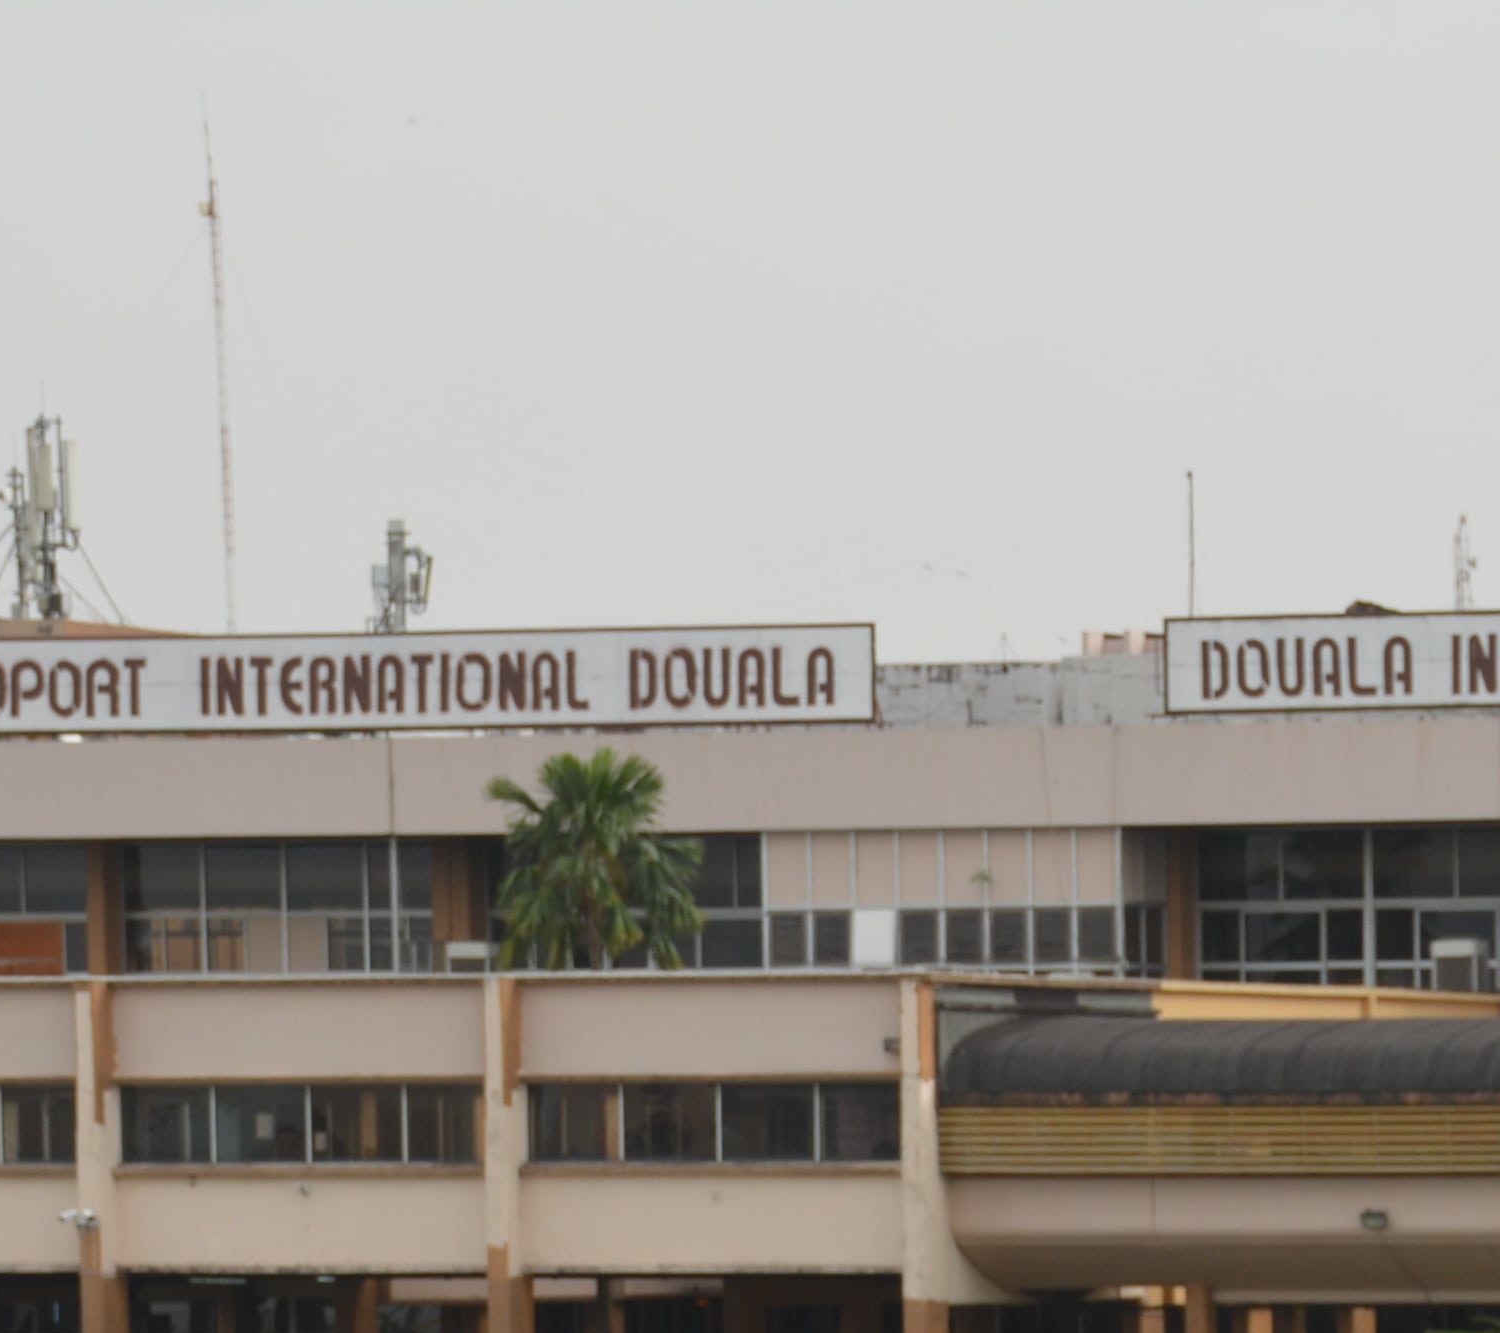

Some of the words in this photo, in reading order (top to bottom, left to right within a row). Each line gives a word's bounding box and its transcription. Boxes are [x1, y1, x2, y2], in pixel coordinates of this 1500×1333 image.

[200, 650, 590, 717] INTERNATIONAL
[628, 646, 836, 710] DOUALA
[1201, 634, 1413, 700] DOUALA
